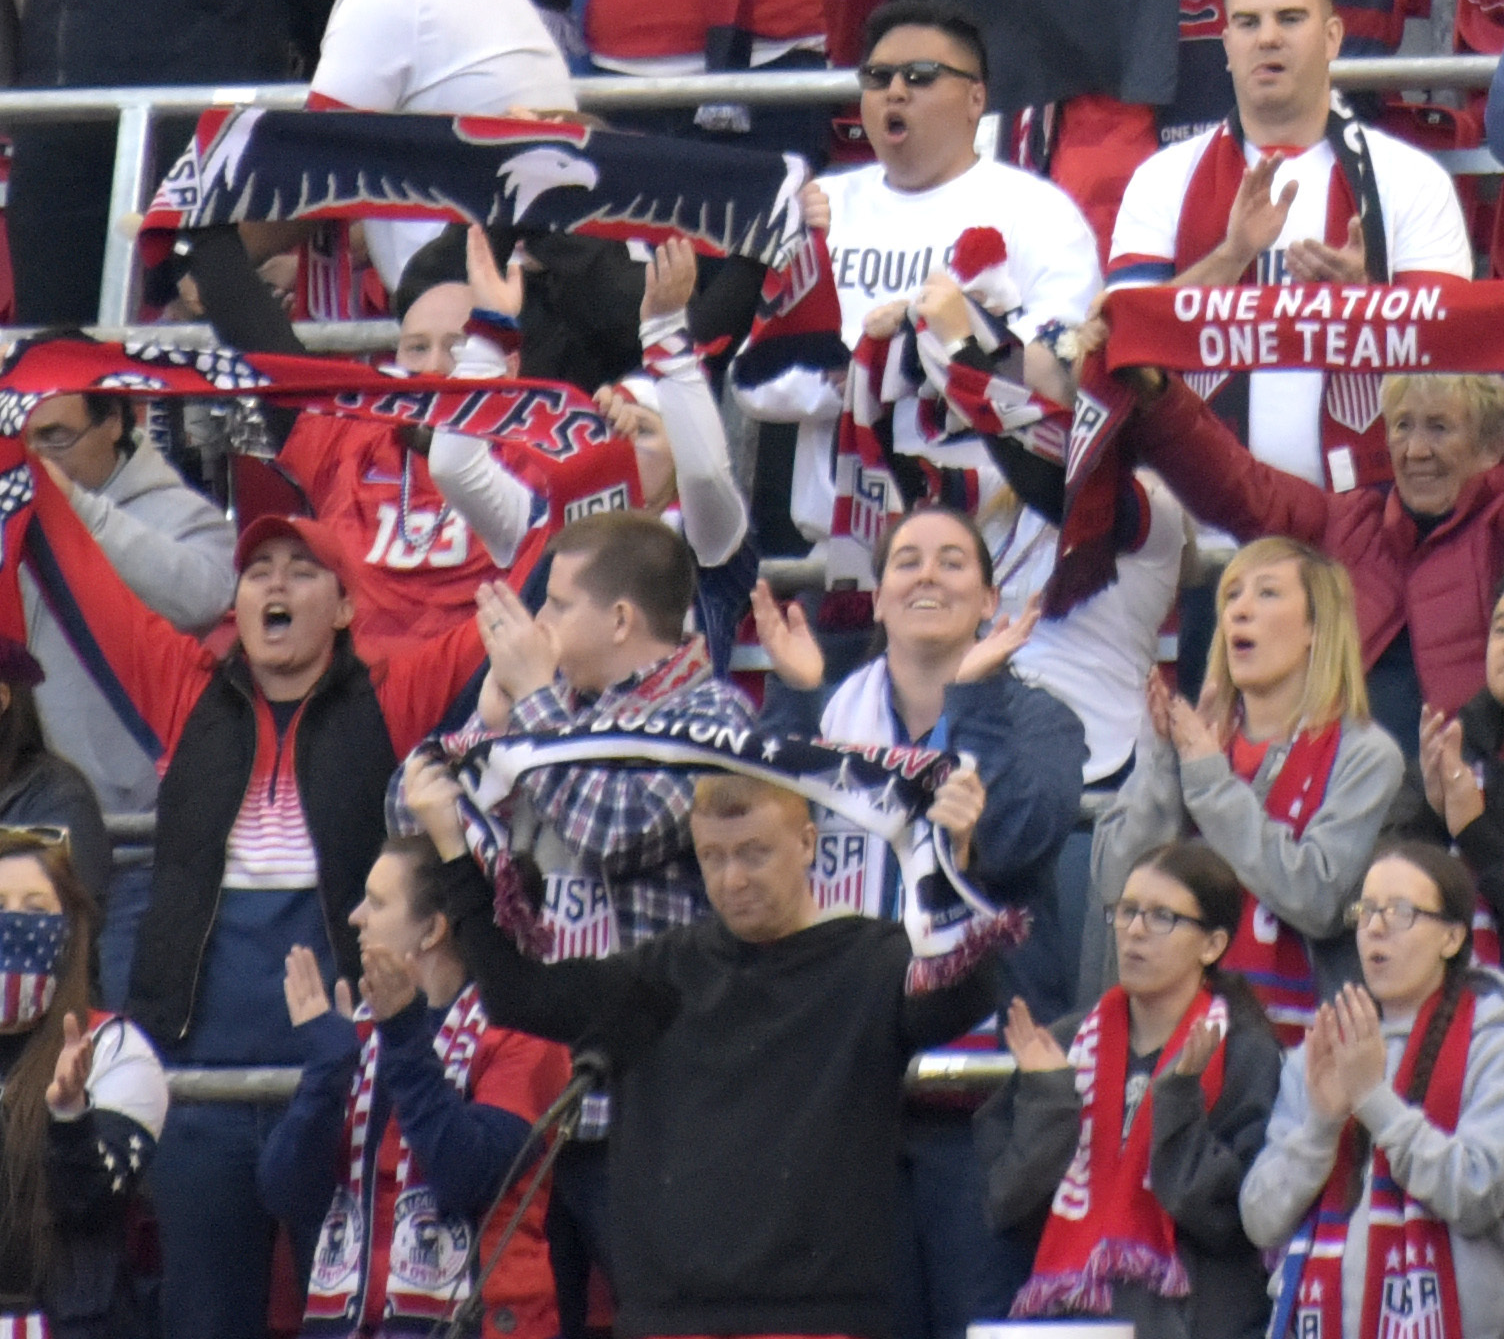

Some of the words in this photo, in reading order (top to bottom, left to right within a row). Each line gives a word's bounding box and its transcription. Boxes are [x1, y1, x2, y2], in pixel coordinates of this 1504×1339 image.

[1174, 286, 1257, 322] ONE
[1272, 287, 1447, 321] NATION.
[1198, 326, 1278, 366] ONE
[1298, 322, 1432, 366] TEAM.
[588, 710, 751, 754] BOSTON
[812, 836, 864, 880] SA
